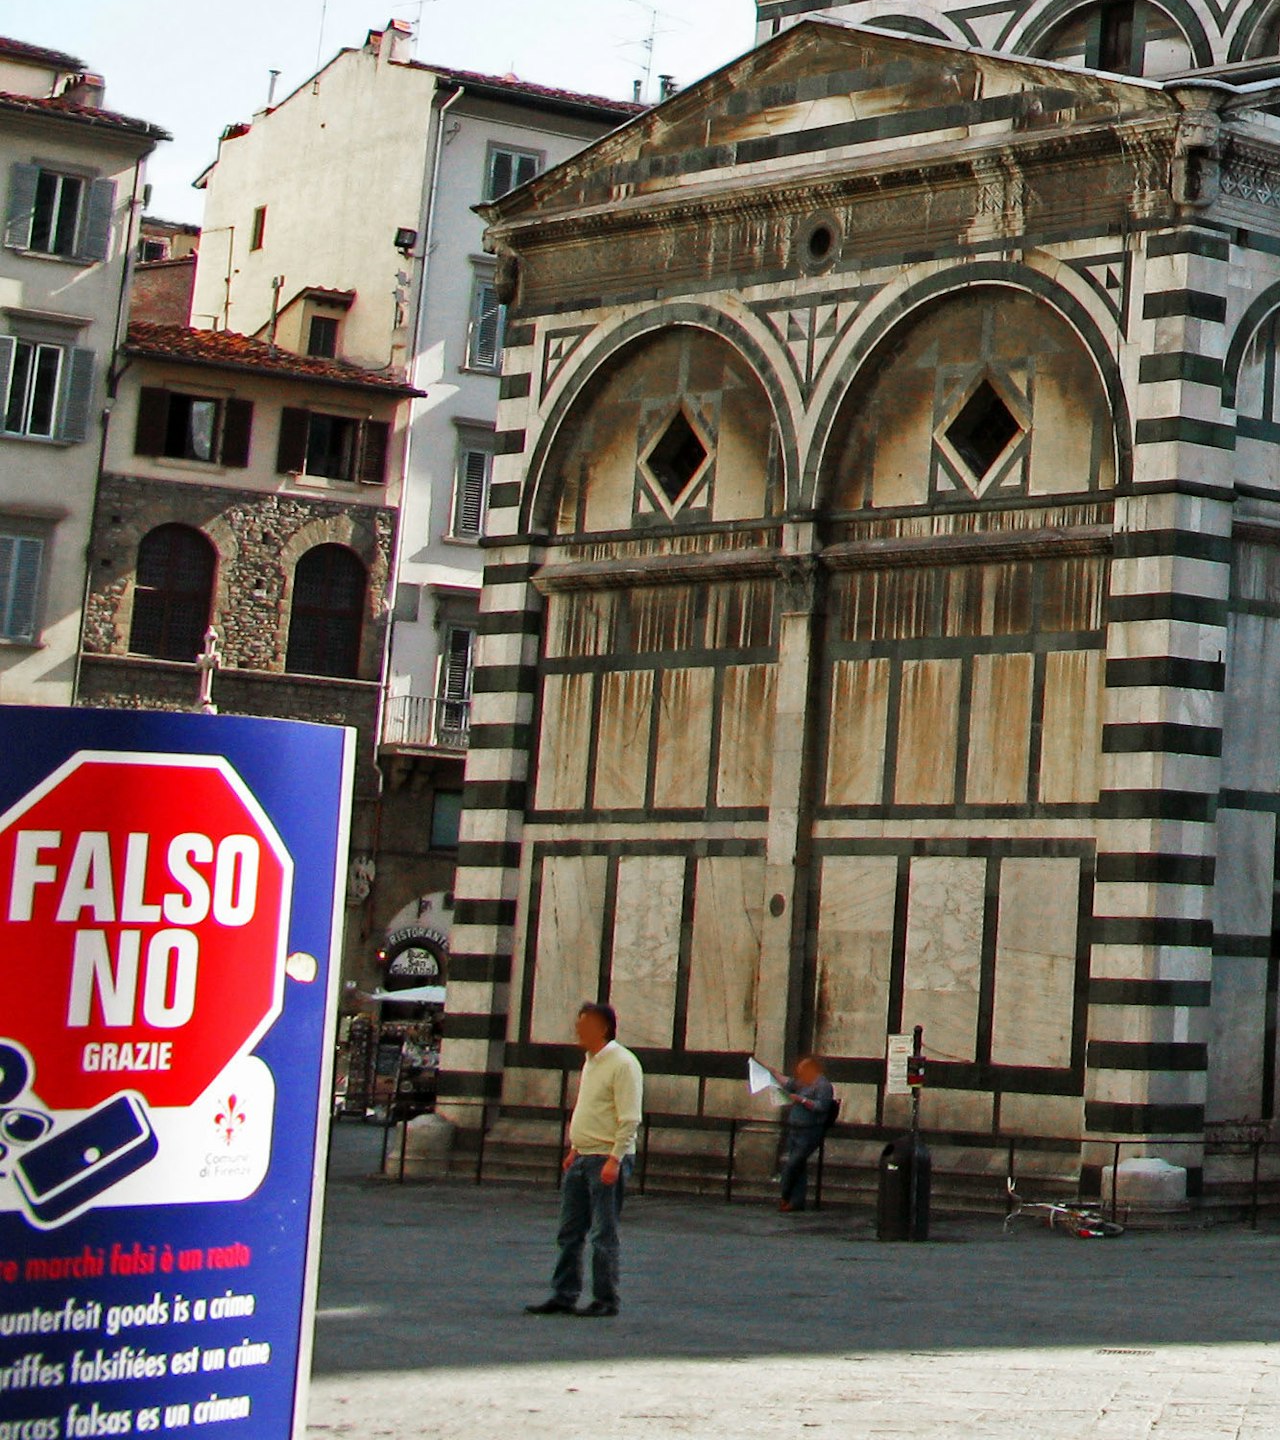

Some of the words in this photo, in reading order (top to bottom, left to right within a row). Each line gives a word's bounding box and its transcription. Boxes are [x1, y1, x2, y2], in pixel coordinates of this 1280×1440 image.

[8, 830, 260, 926] FALSO
[388, 927, 449, 951] RISTORANTE
[67, 929, 200, 1028] NO
[83, 1042, 173, 1072] GRAZIE
[25, 1246, 105, 1279] marchi
[110, 1242, 156, 1275] falsi
[160, 1243, 174, 1273] è
[178, 1249, 203, 1271] un
[206, 1241, 252, 1269] reato
[106, 1291, 169, 1335] goods
[173, 1294, 190, 1323] is
[193, 1299, 206, 1321] a
[210, 1289, 255, 1320] crime
[0, 1353, 65, 1392] riffes
[70, 1346, 167, 1384] falsifiées
[171, 1346, 199, 1375] est
[202, 1348, 226, 1371] un
[227, 1338, 271, 1369] crime
[66, 1402, 132, 1438] falsas
[136, 1407, 160, 1432] es
[164, 1404, 190, 1429] un
[193, 1393, 251, 1425] crimen
